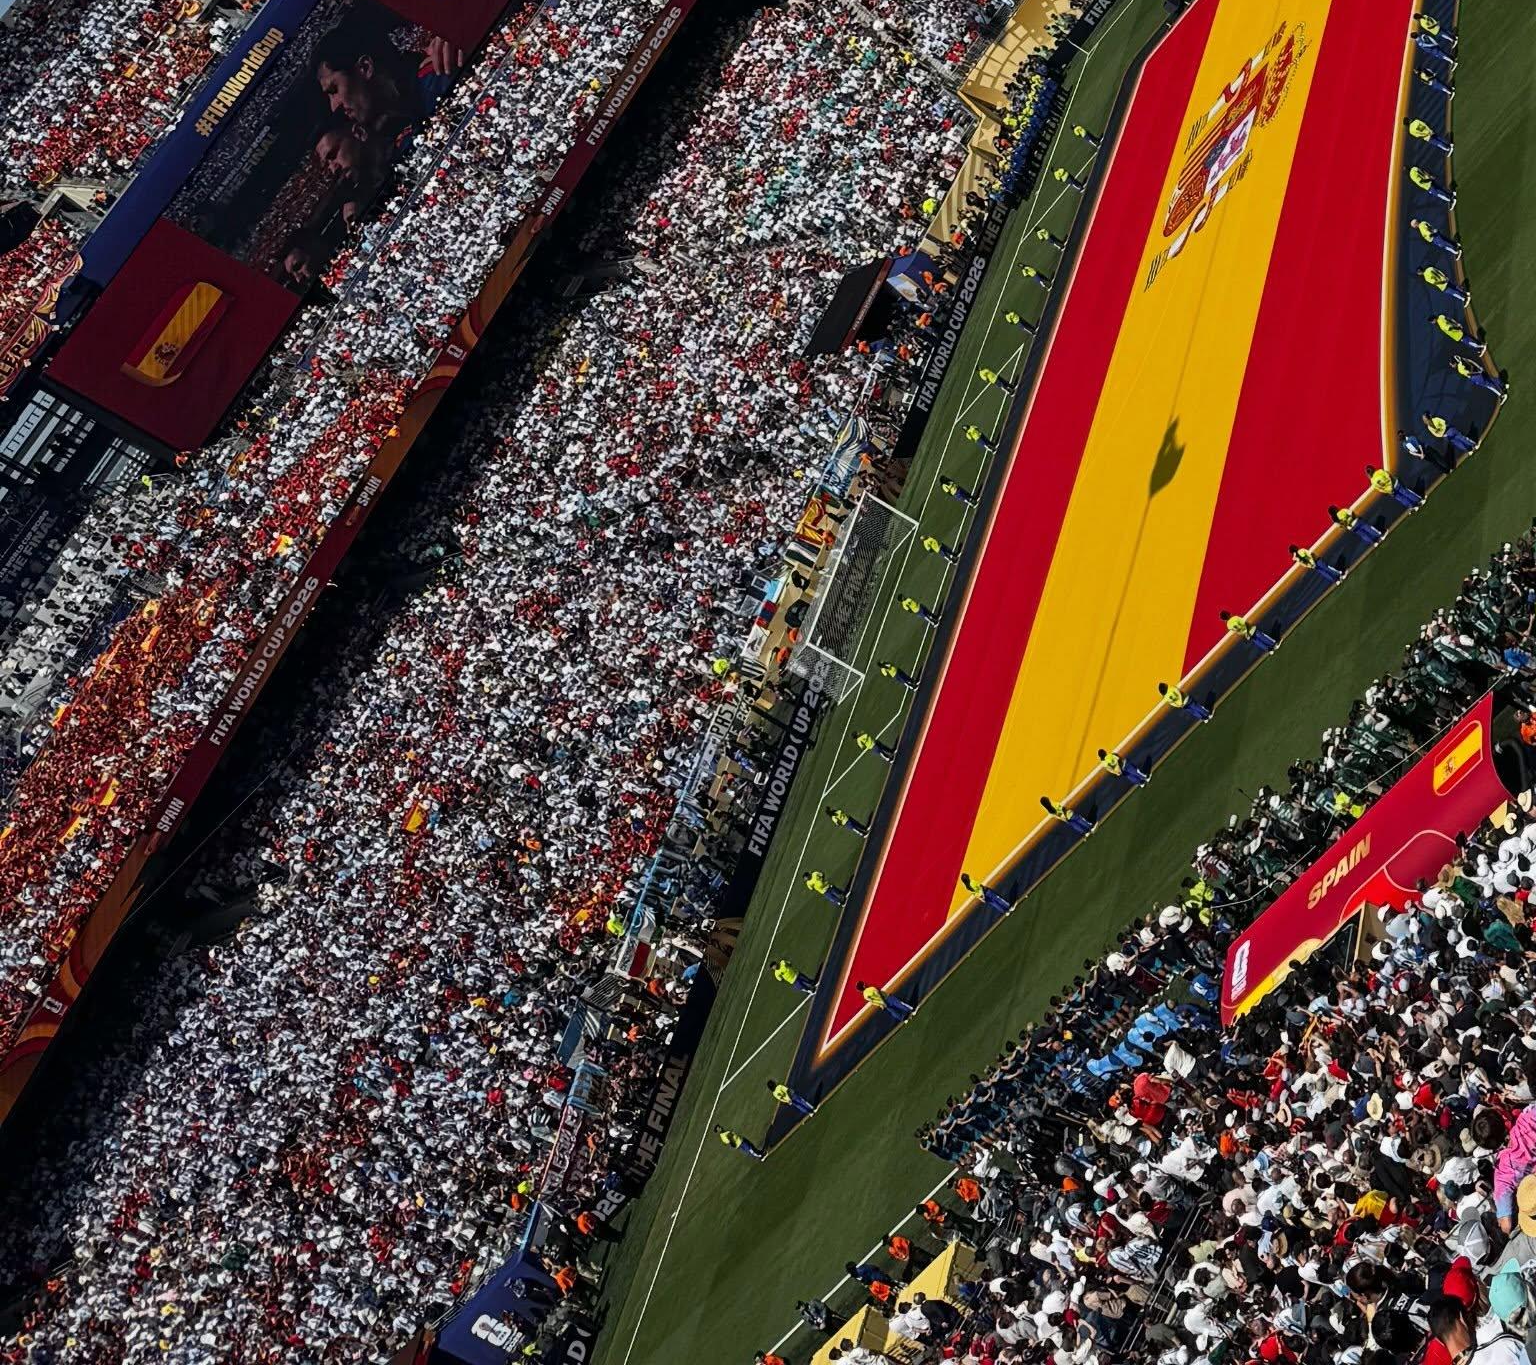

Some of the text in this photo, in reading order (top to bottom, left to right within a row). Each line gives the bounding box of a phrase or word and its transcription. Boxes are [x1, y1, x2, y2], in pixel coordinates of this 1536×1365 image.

[193, 25, 286, 138] #FIFAWorldCup
[584, 4, 683, 146] FIFA WORLD CUP 2026
[540, 185, 566, 217] SPAIN
[913, 254, 989, 413] FIFA WORLD CUP 2026
[356, 474, 383, 508] SPAIN
[22, 511, 59, 558] FINAL
[207, 574, 320, 747] FIFA WORLD CUP 2026
[156, 795, 185, 834] SPAIN
[745, 743, 801, 857] FIFA WORLD
[1308, 831, 1374, 910] SPAIN
[641, 1049, 693, 1134] FINAL
